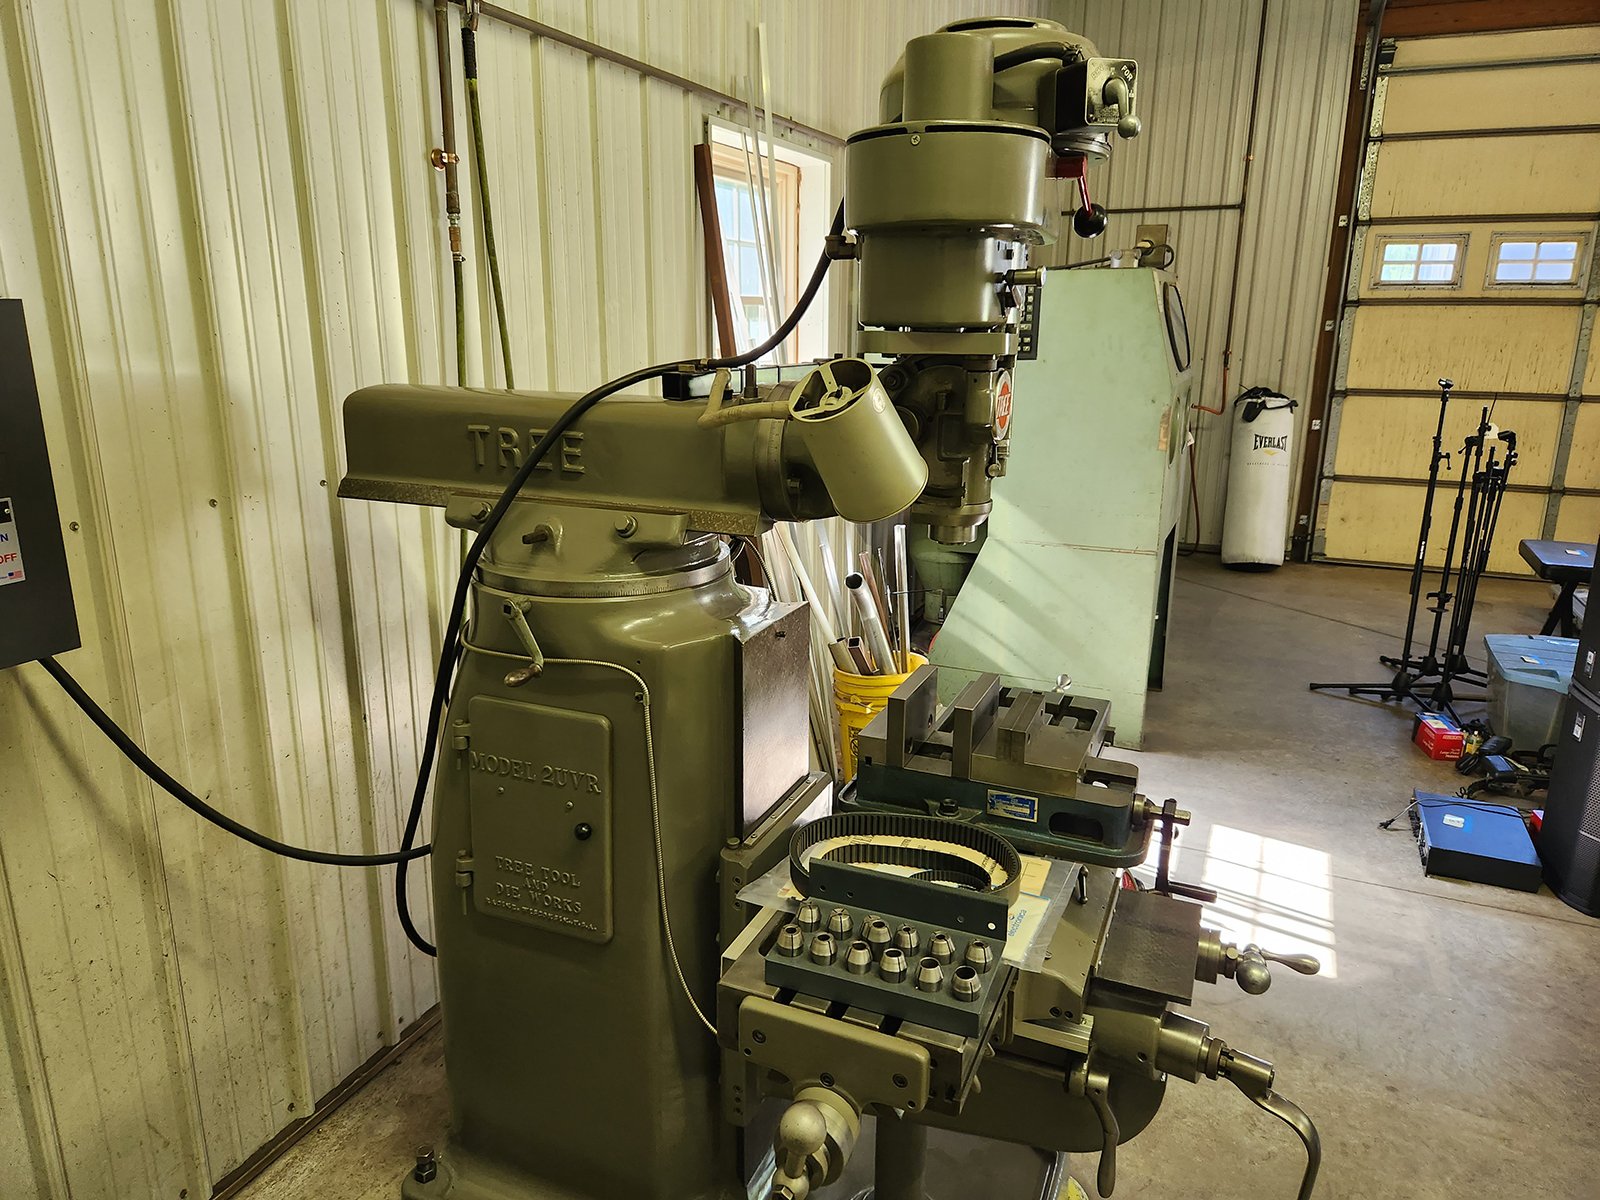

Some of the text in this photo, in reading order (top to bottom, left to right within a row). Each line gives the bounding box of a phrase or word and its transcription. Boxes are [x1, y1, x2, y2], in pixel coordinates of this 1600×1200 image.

[1121, 64, 1134, 81] FOR
[467, 424, 585, 474] TREE
[1253, 433, 1288, 452] EVERLAST
[470, 750, 602, 793] MODEL 2UVR
[495, 855, 581, 887] TREE TOOL
[523, 877, 549, 893] AND
[496, 882, 582, 914] DIE WORKS
